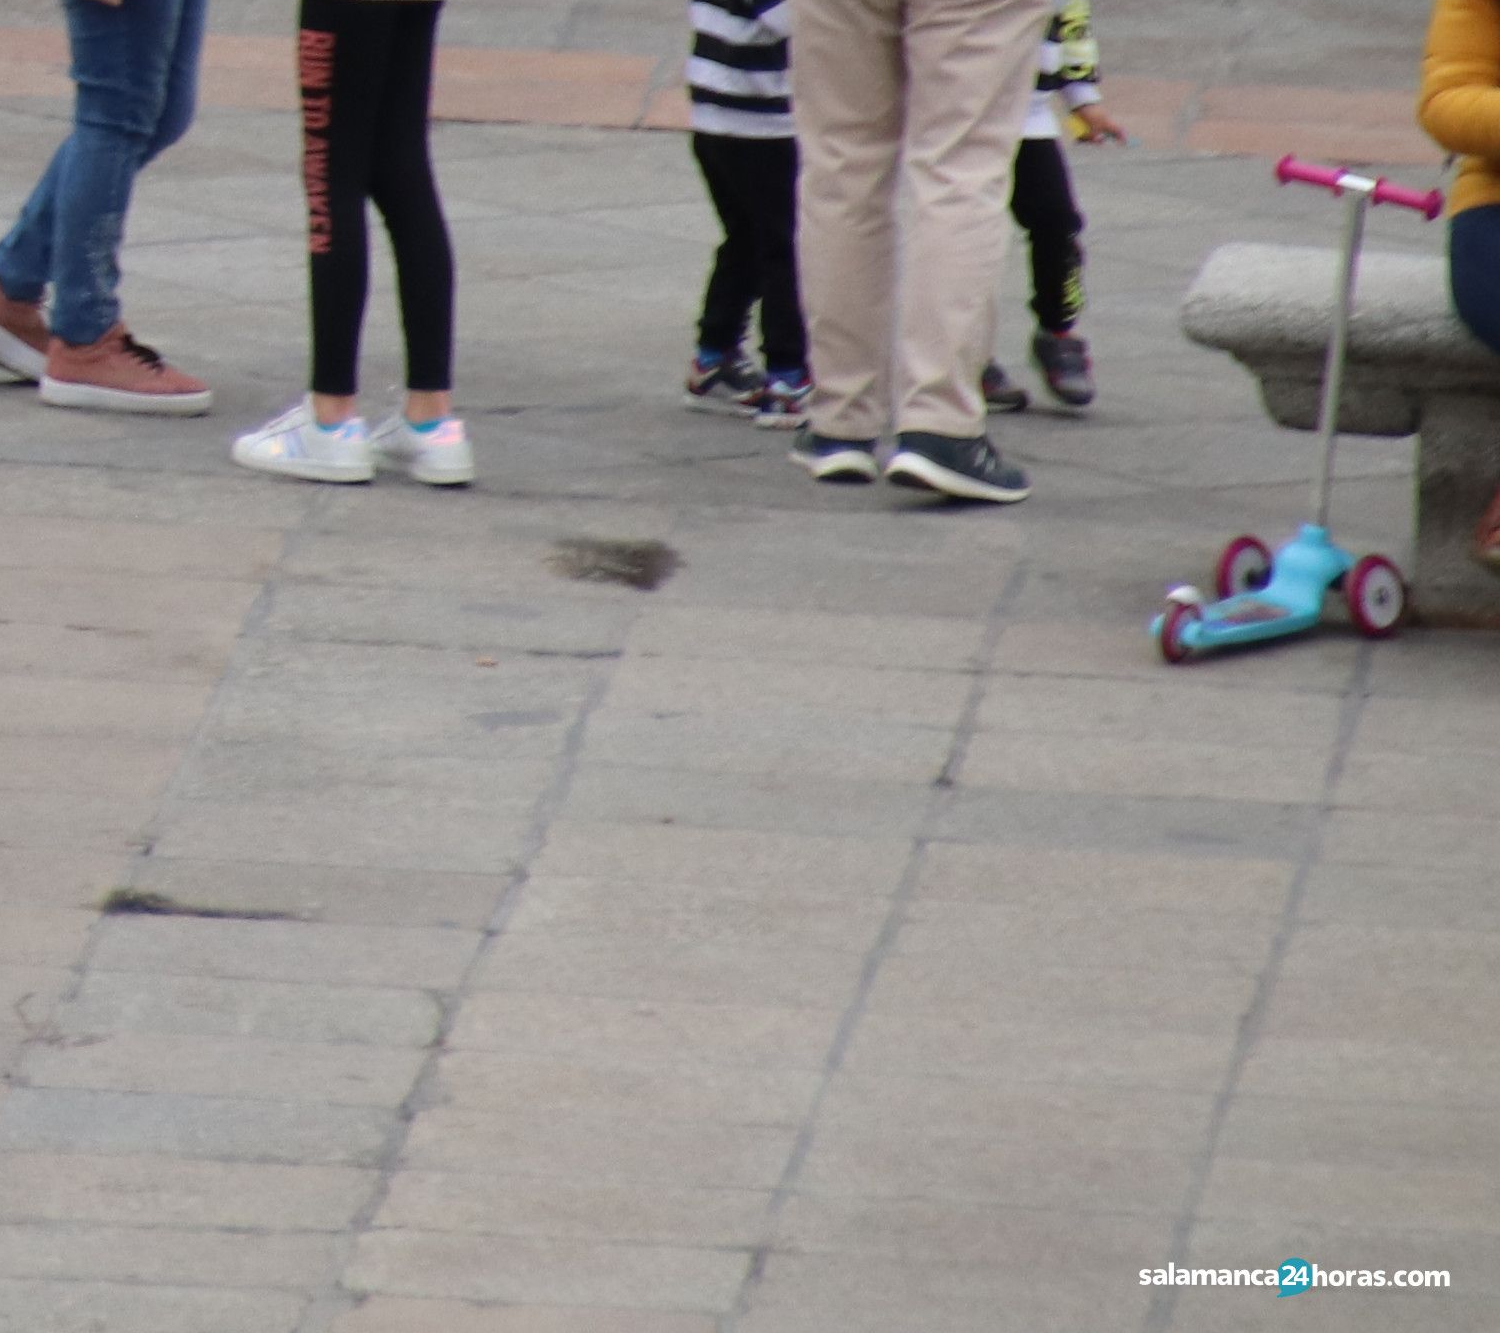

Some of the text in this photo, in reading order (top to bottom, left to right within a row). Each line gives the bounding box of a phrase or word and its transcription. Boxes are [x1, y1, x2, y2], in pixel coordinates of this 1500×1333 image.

[299, 29, 336, 255] RUN TO AWAKEN
